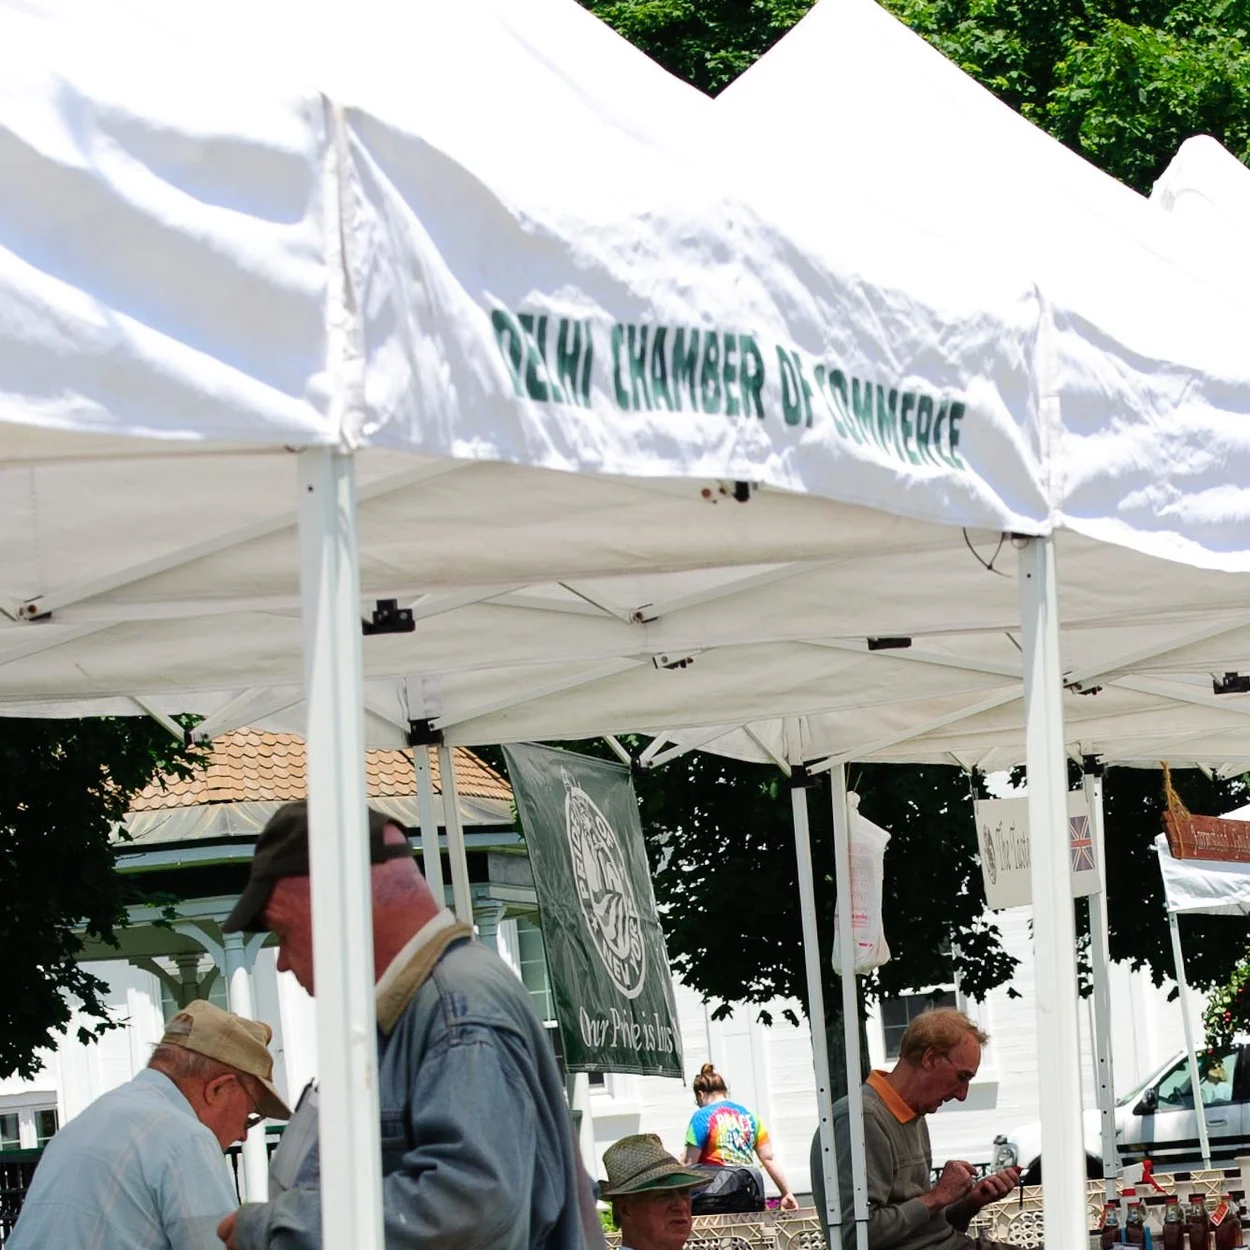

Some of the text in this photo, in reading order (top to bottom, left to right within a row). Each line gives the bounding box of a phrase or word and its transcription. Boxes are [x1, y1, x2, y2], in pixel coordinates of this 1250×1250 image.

[491, 309, 593, 404] DELHI
[611, 322, 764, 419] CHAMBER
[814, 364, 965, 470] COMMERCE
[580, 1006, 609, 1048] Our
